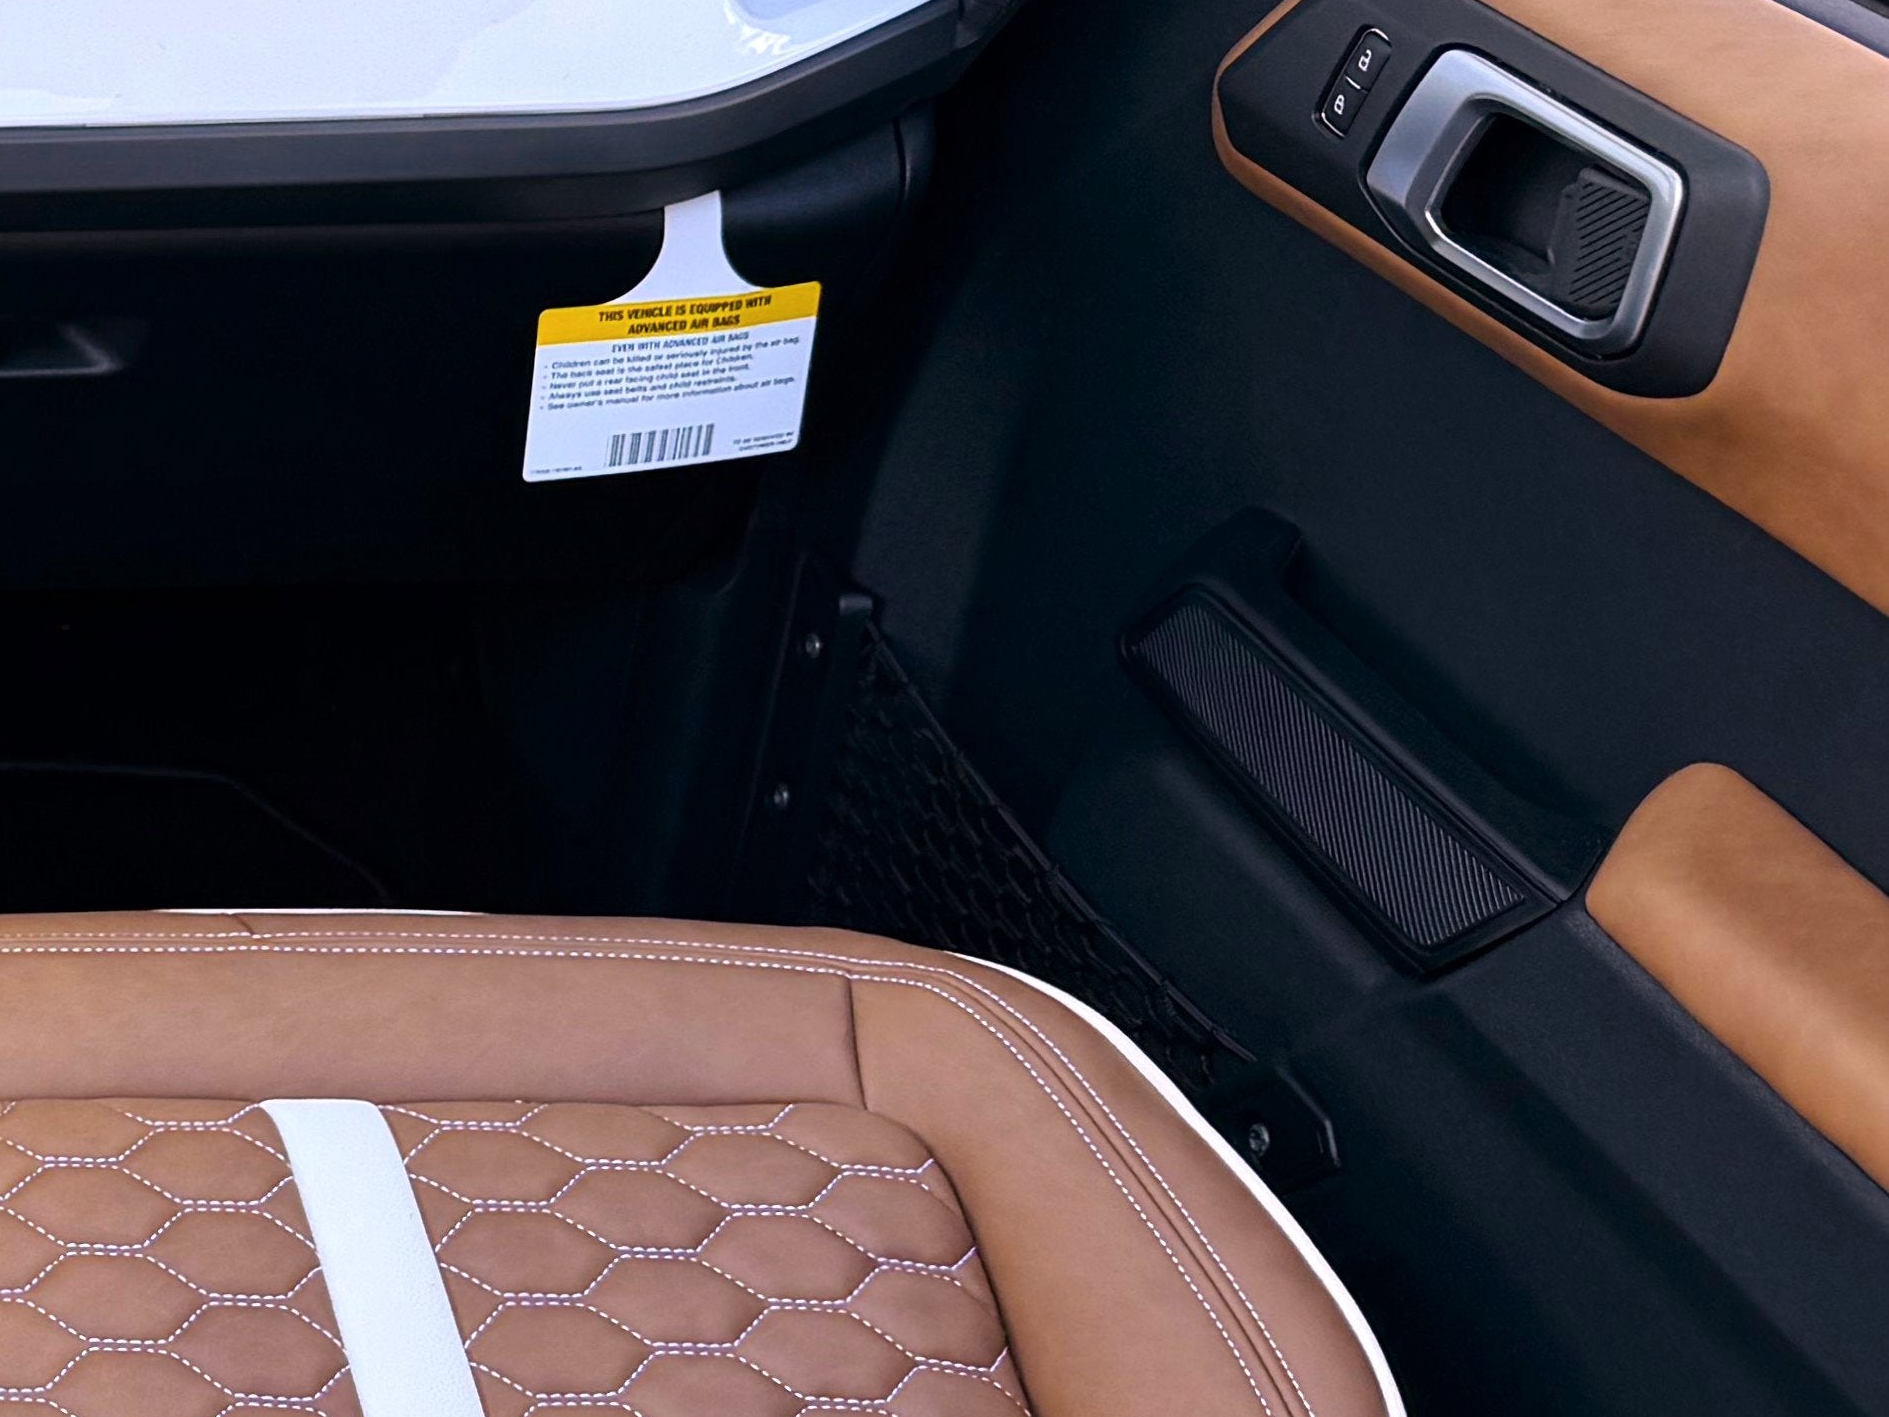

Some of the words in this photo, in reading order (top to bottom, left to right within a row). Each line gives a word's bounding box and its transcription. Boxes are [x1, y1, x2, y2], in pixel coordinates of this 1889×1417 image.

[599, 311, 624, 322] THIS
[628, 306, 672, 320] VEHICLE
[675, 305, 686, 317] IS
[689, 300, 743, 315] EQUIPPED
[745, 295, 772, 308] WITH
[628, 320, 686, 335] ADVANCED
[690, 316, 709, 330] AIR
[712, 314, 740, 327] BAGS
[662, 336, 709, 349] ADVANCED
